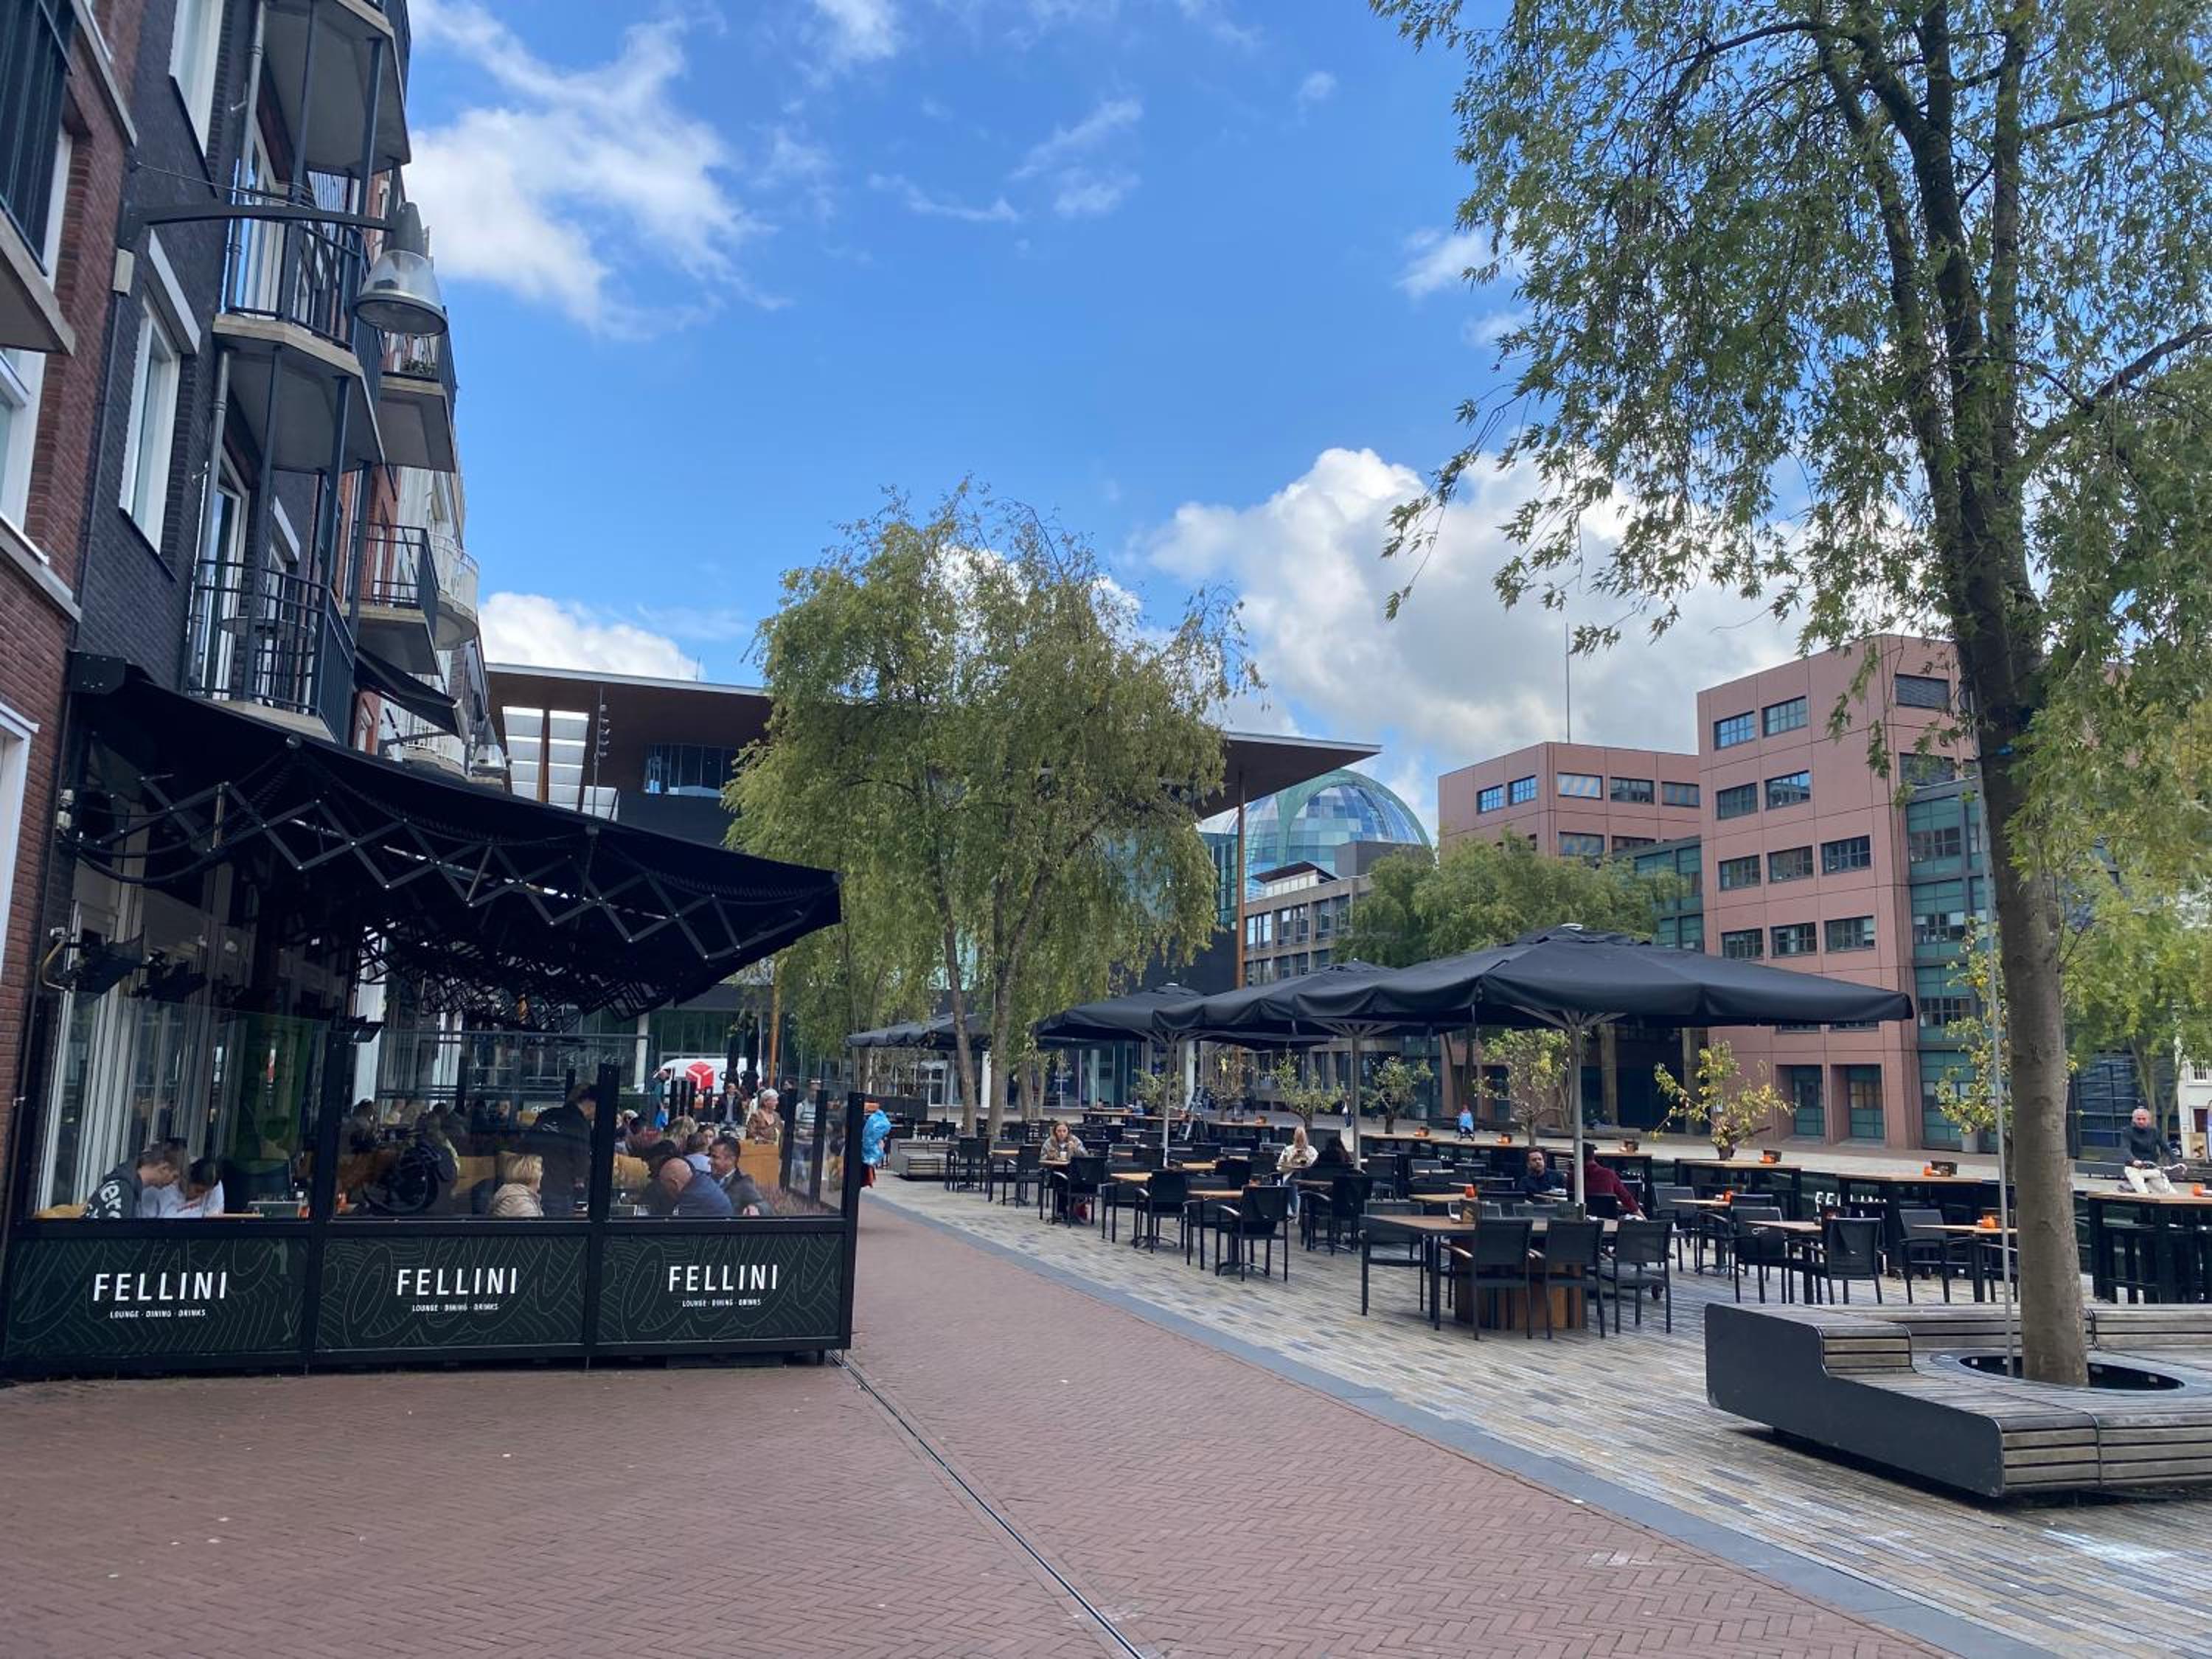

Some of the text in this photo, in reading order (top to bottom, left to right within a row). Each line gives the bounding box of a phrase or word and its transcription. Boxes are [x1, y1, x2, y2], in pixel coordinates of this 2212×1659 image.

[93, 1271, 227, 1301] FELLINI
[396, 1267, 517, 1296] FELLINI
[668, 1264, 778, 1292] FELLINI
[110, 1309, 206, 1319] LOUNGE DINING DRINKS
